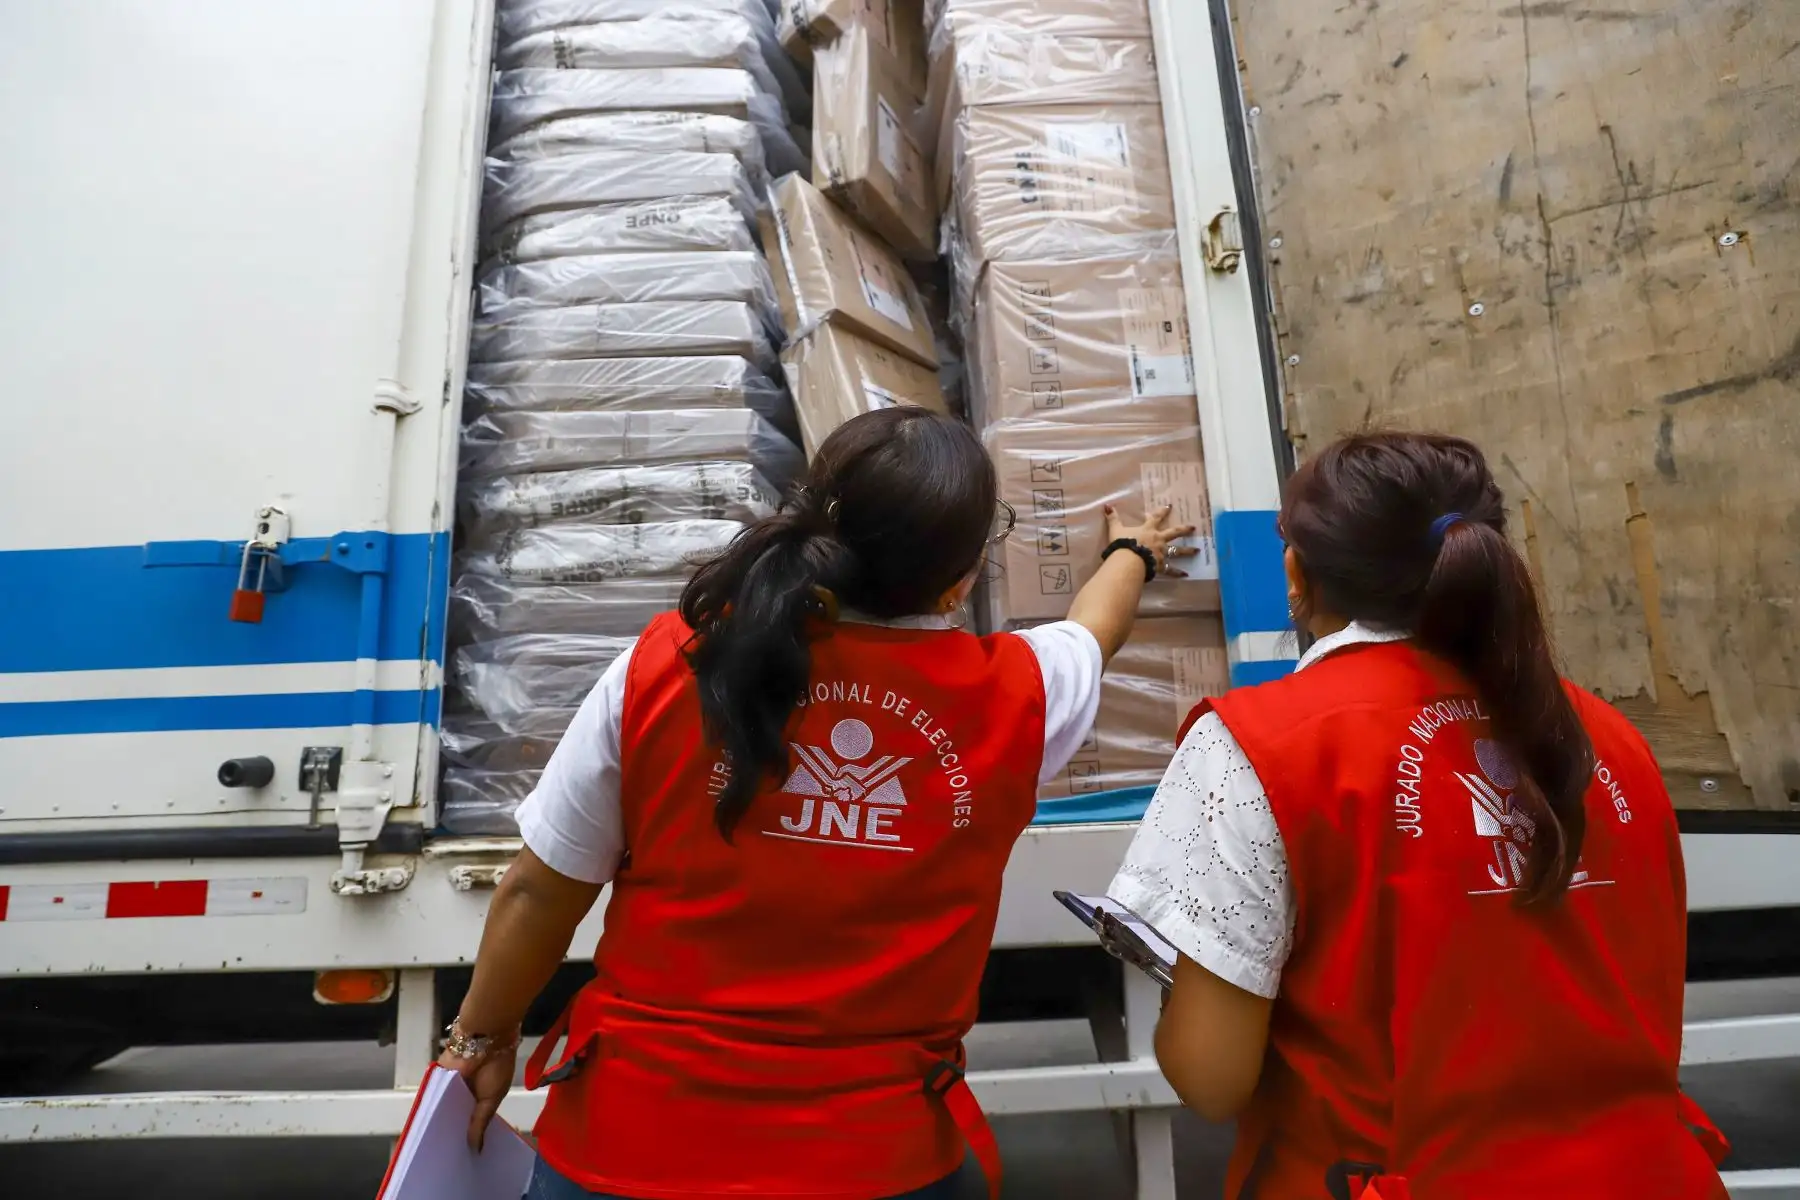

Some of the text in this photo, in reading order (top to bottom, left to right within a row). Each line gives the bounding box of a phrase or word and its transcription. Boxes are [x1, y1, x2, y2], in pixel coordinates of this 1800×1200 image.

[625, 214, 682, 228] ONPE
[881, 690, 911, 718] DE
[911, 709, 972, 828] ELECCIONES
[1395, 699, 1632, 838] JURADO NACIONAL IONES
[780, 799, 902, 841] JNE
